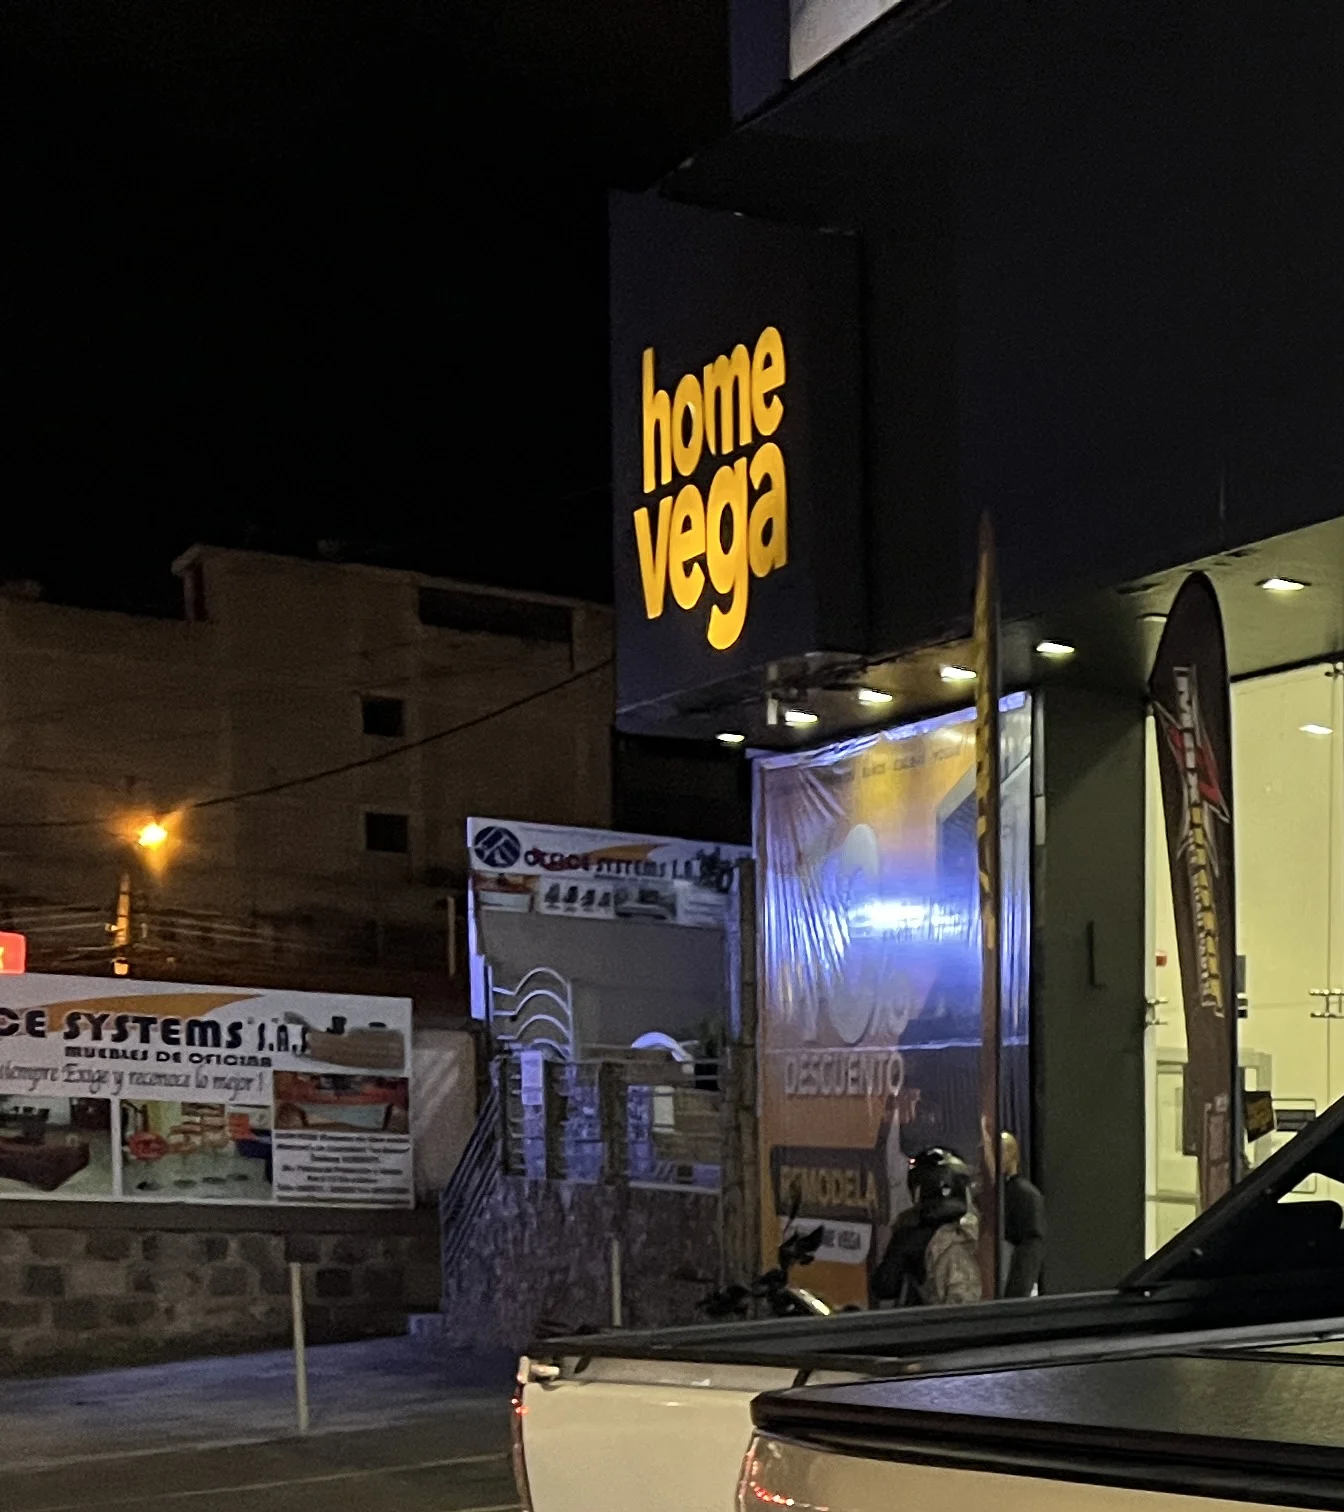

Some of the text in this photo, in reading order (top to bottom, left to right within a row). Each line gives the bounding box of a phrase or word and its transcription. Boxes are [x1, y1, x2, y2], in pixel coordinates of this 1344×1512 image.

[642, 326, 786, 494] home
[633, 442, 789, 650] vega
[62, 1010, 243, 1050] SYSTEMS
[64, 1045, 272, 1068] MUEBLES DE OFICINA
